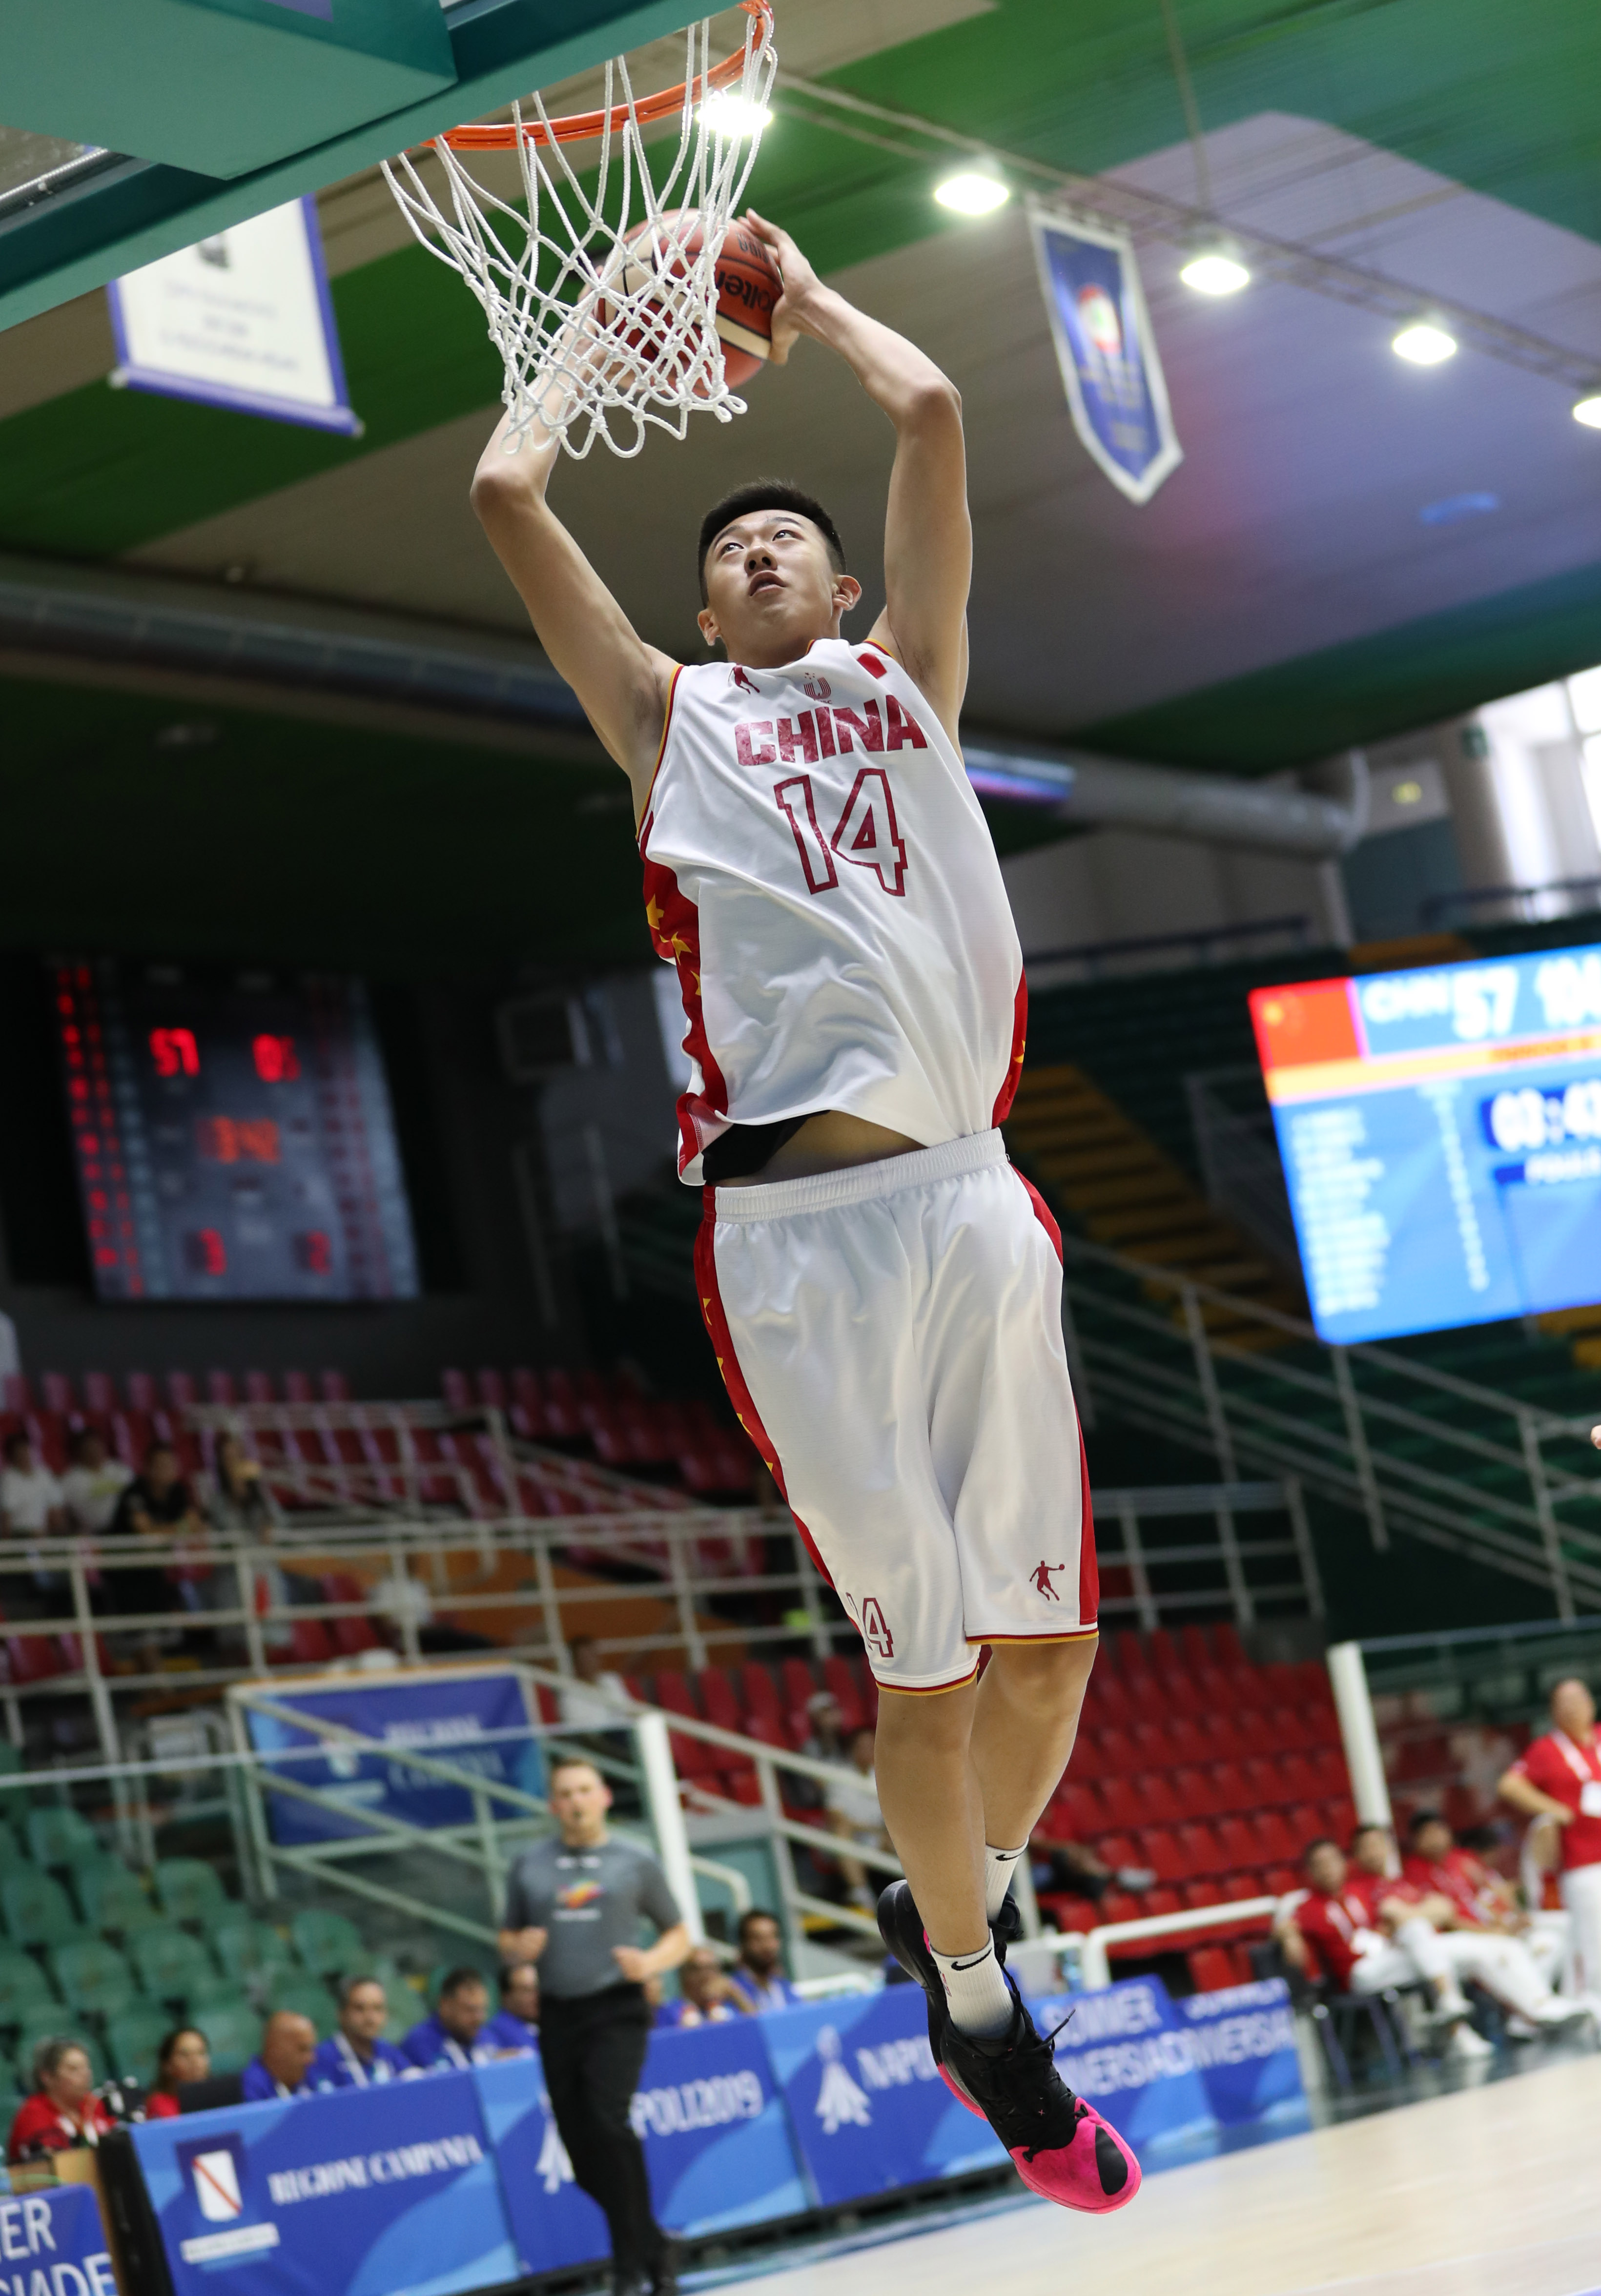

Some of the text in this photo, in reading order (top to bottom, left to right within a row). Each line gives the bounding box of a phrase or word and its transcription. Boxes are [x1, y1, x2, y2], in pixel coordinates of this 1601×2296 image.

[735, 695, 927, 766] CHINA
[774, 768, 908, 897] 14
[1452, 965, 1519, 1041] 57
[148, 1026, 201, 1078] 57
[629, 2070, 763, 2140] POLI2019
[0, 2197, 58, 2262] ER
